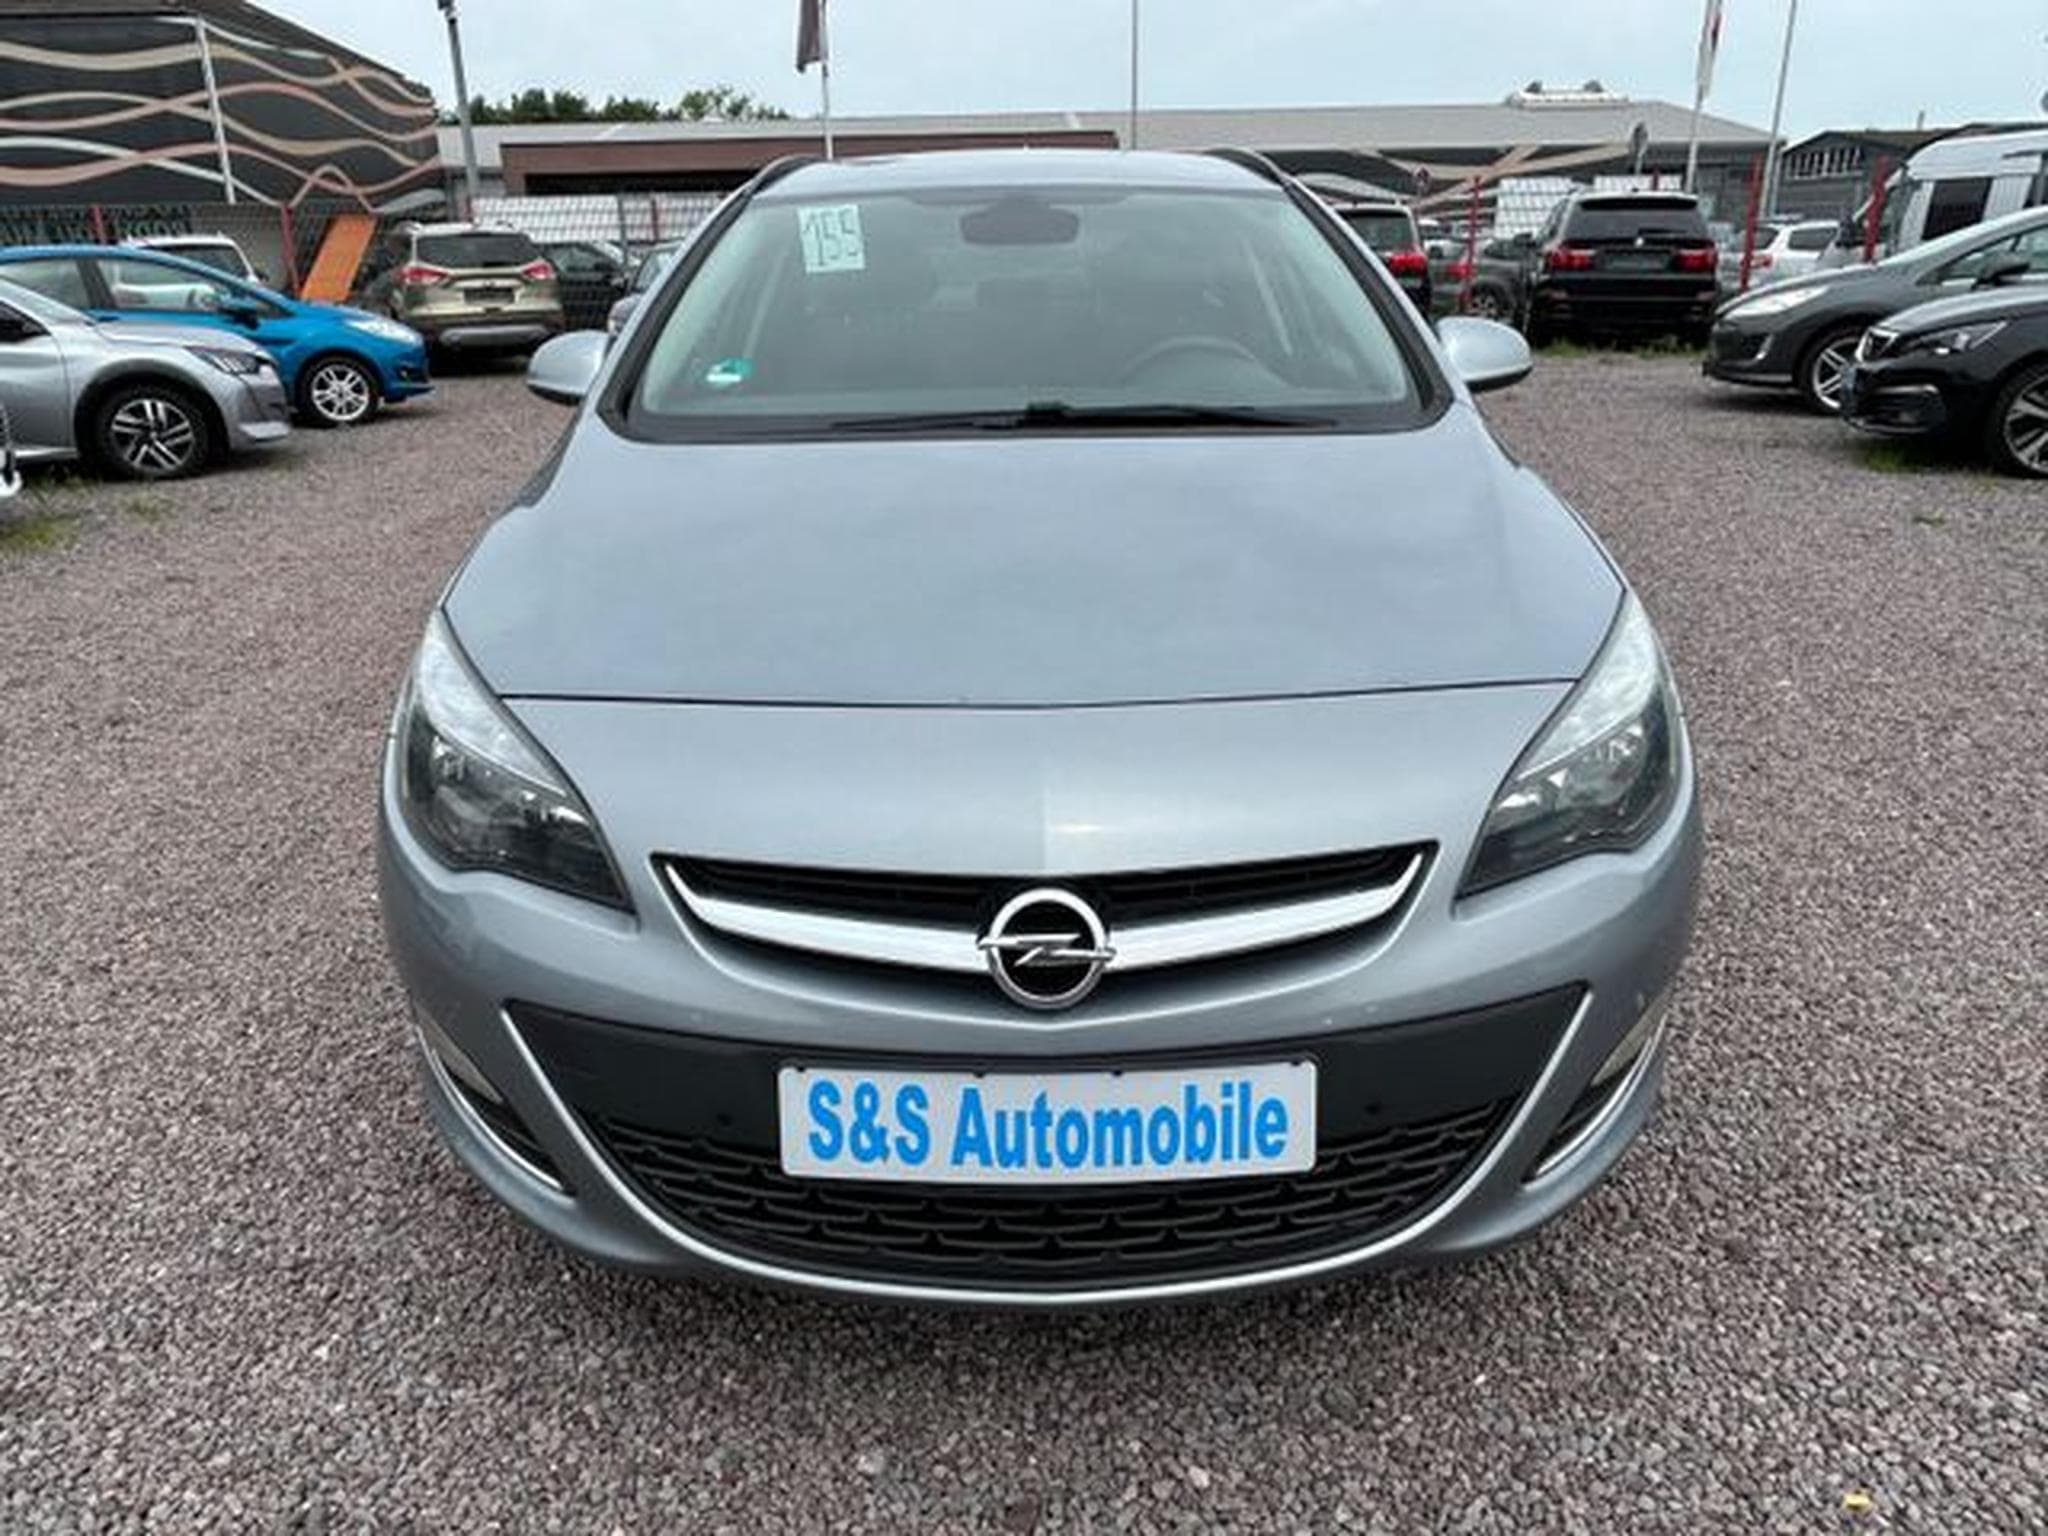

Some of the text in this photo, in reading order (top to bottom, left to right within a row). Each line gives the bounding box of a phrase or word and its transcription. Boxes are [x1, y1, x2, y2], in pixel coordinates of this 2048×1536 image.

[804, 208, 860, 267] 155
[808, 1080, 1288, 1169] S&S Automobile
